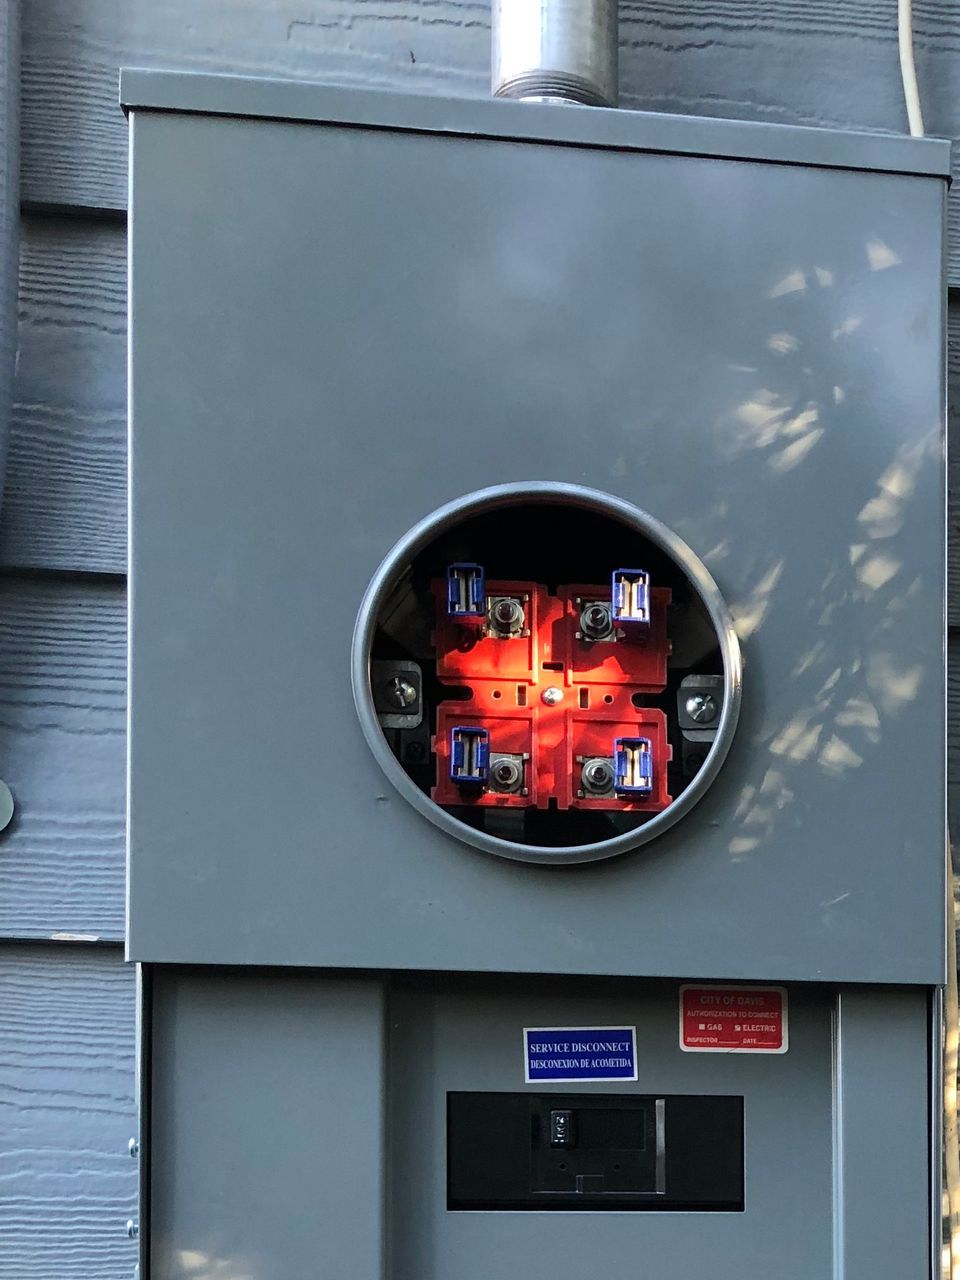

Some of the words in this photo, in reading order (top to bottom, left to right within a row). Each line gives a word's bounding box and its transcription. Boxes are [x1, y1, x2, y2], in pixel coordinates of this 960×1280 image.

[530, 1043, 570, 1053] SERVICE
[571, 1042, 631, 1052] DISCONNECT
[530, 1058, 579, 1069] DESCONEXION
[580, 1058, 590, 1068] DE
[590, 1057, 632, 1067] ACOMETIDA
